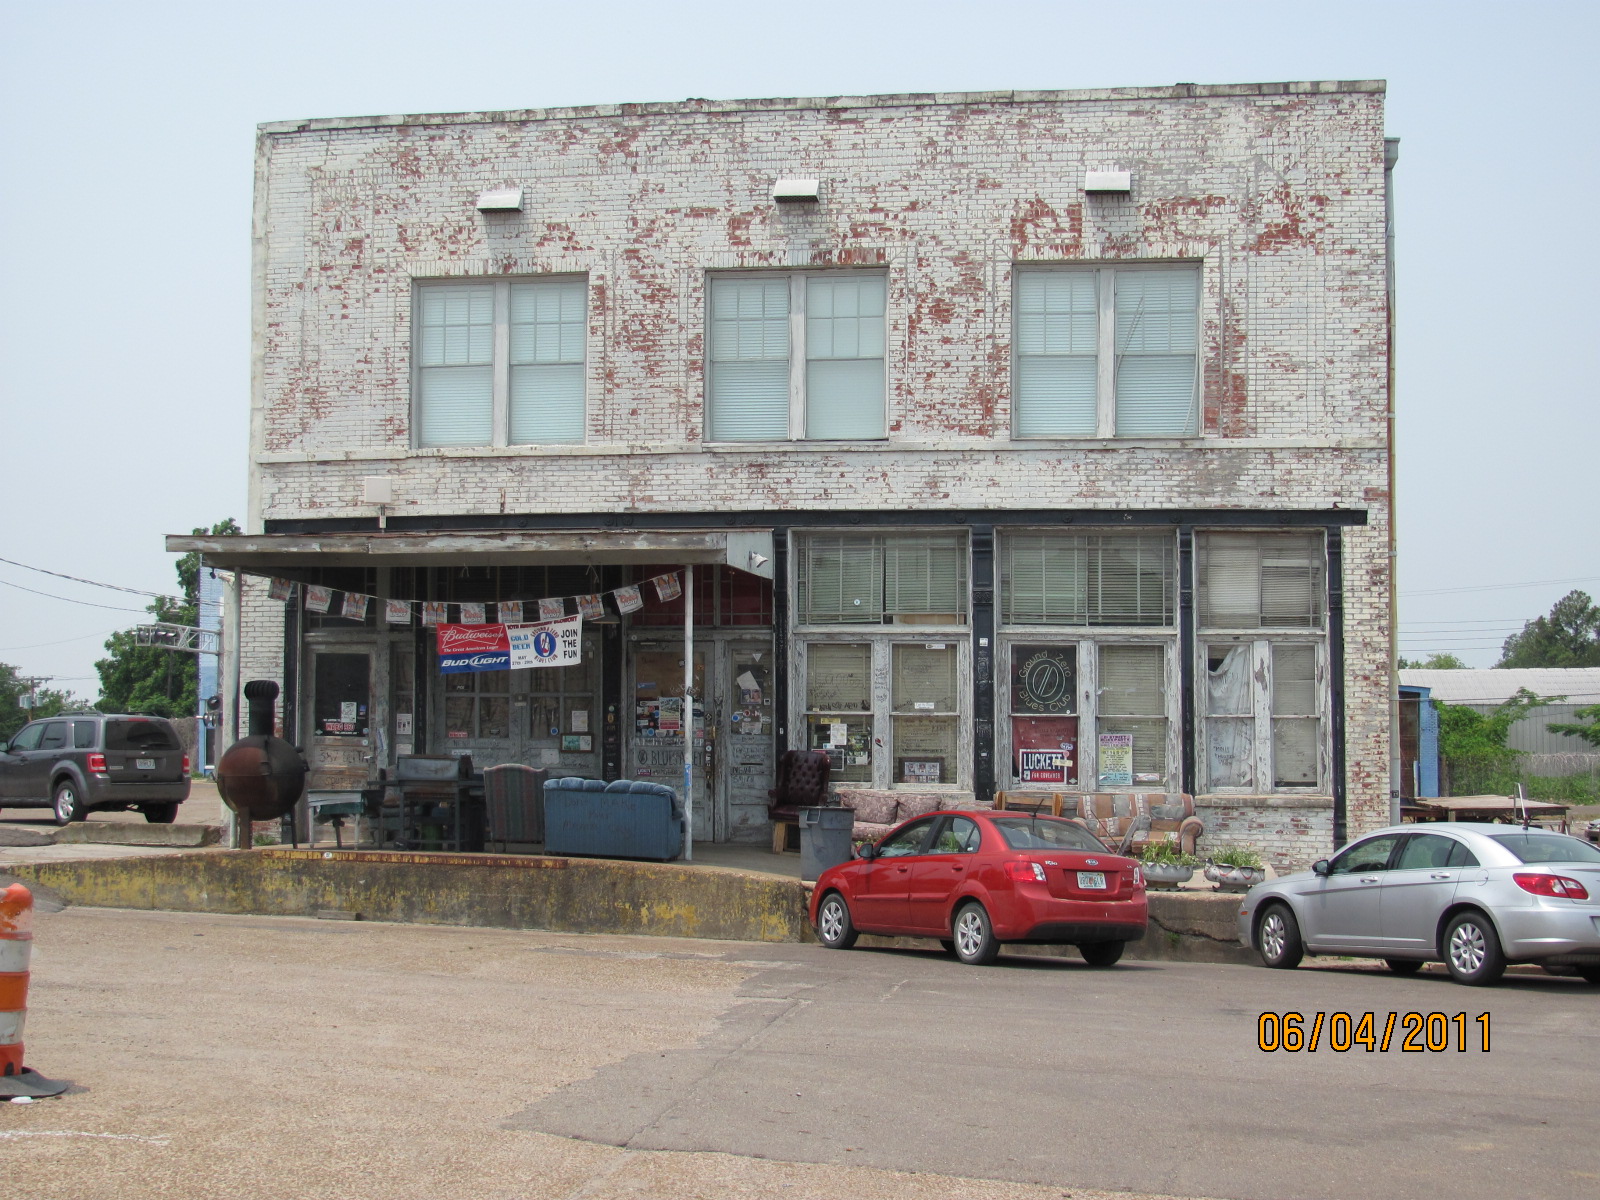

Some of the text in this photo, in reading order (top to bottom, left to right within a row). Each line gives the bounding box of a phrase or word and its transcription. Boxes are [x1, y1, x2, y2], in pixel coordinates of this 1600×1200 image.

[440, 629, 504, 641] Budweiser
[511, 634, 529, 642] COLD
[561, 629, 578, 638] JOIN
[563, 640, 577, 648] THE
[564, 650, 577, 659] FUN
[473, 657, 509, 665] LIGHT
[1018, 650, 1071, 678] Ground Zero
[1019, 690, 1071, 712] Blues Club
[1023, 753, 1062, 770] LUCKETT
